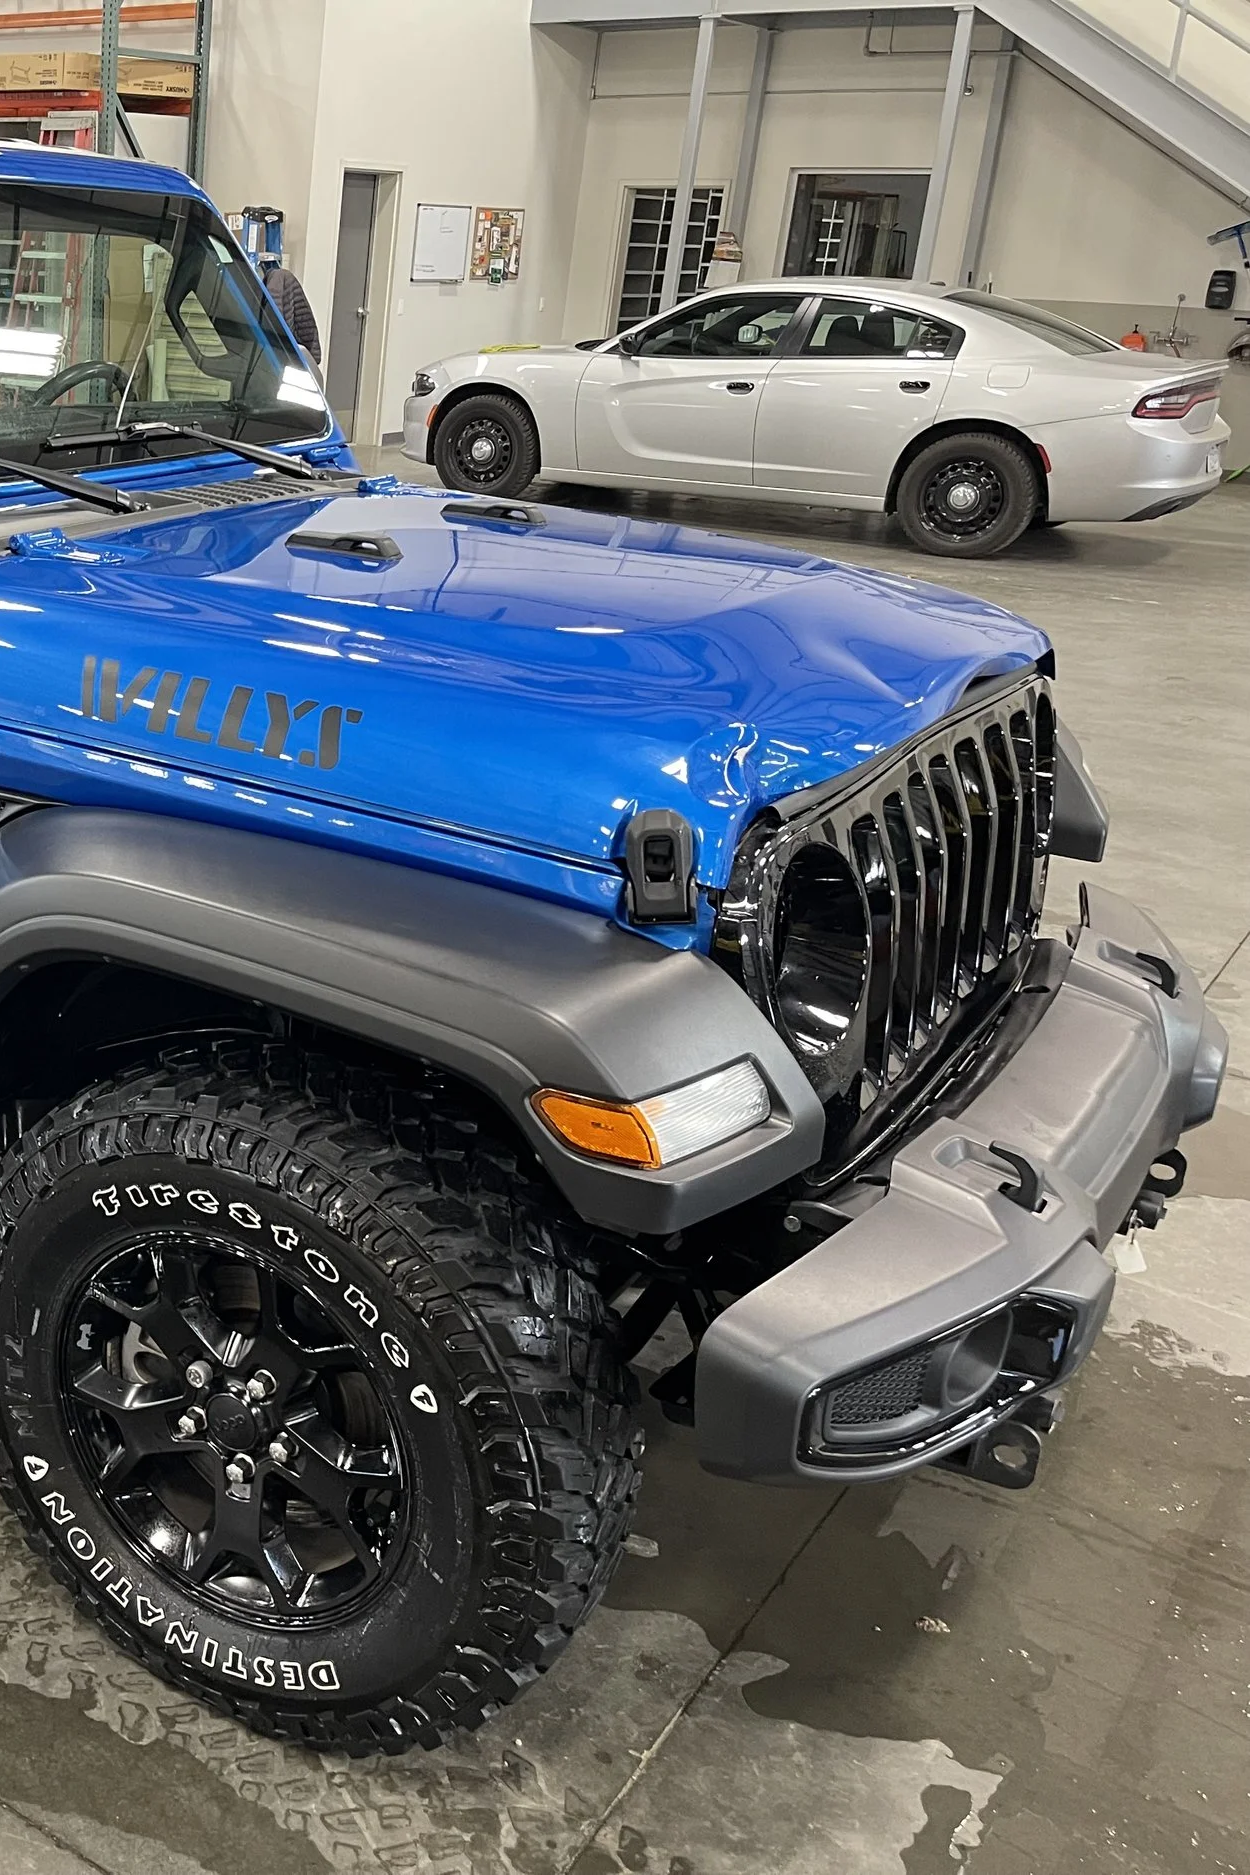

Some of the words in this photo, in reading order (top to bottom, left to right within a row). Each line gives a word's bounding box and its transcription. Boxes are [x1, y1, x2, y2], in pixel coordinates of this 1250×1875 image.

[81, 655, 364, 770] WILLYS
[91, 1181, 411, 1370] Firestone
[41, 1488, 342, 1692] DESTINATION
